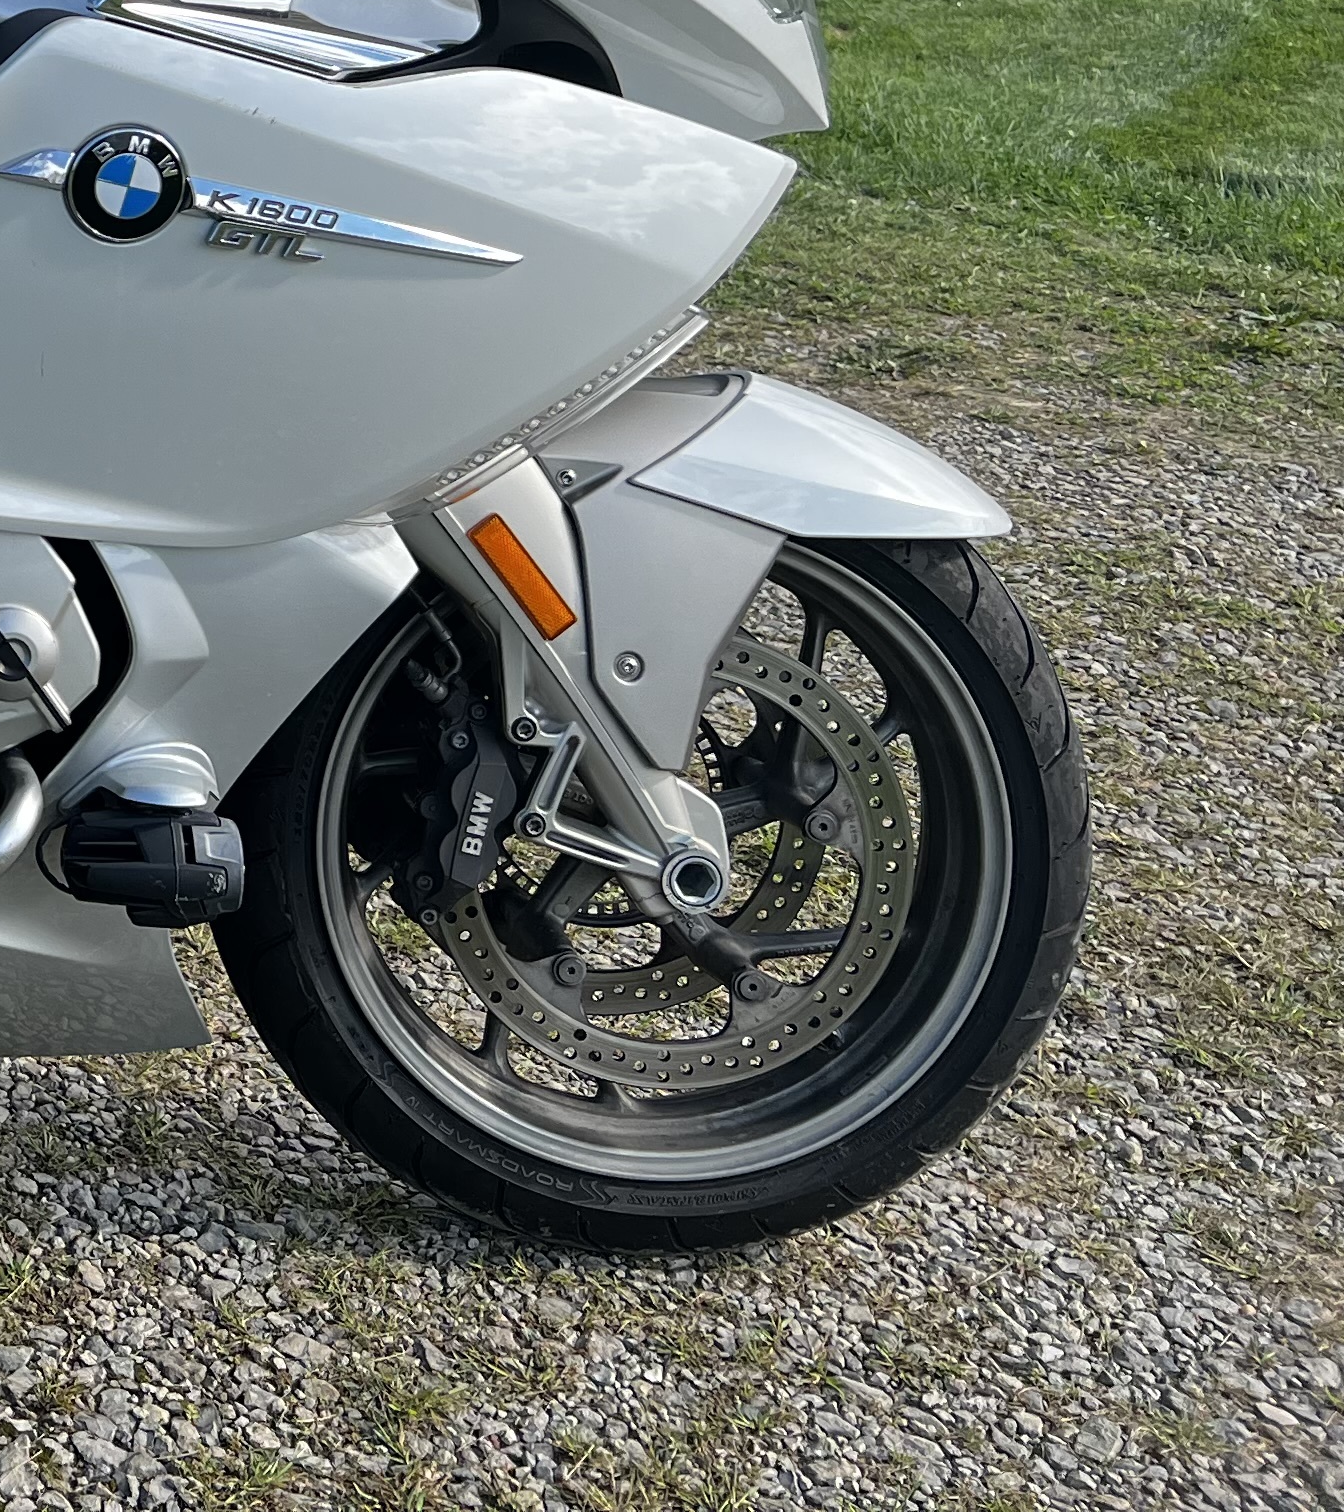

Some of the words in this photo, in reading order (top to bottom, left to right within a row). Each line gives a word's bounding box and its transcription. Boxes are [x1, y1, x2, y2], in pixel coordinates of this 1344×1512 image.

[91, 134, 180, 180] BMW
[208, 189, 241, 213] K
[244, 196, 341, 230] 1600
[208, 219, 327, 264] GTL
[460, 790, 495, 858] BMW
[422, 1111, 575, 1192] ROADSMART
